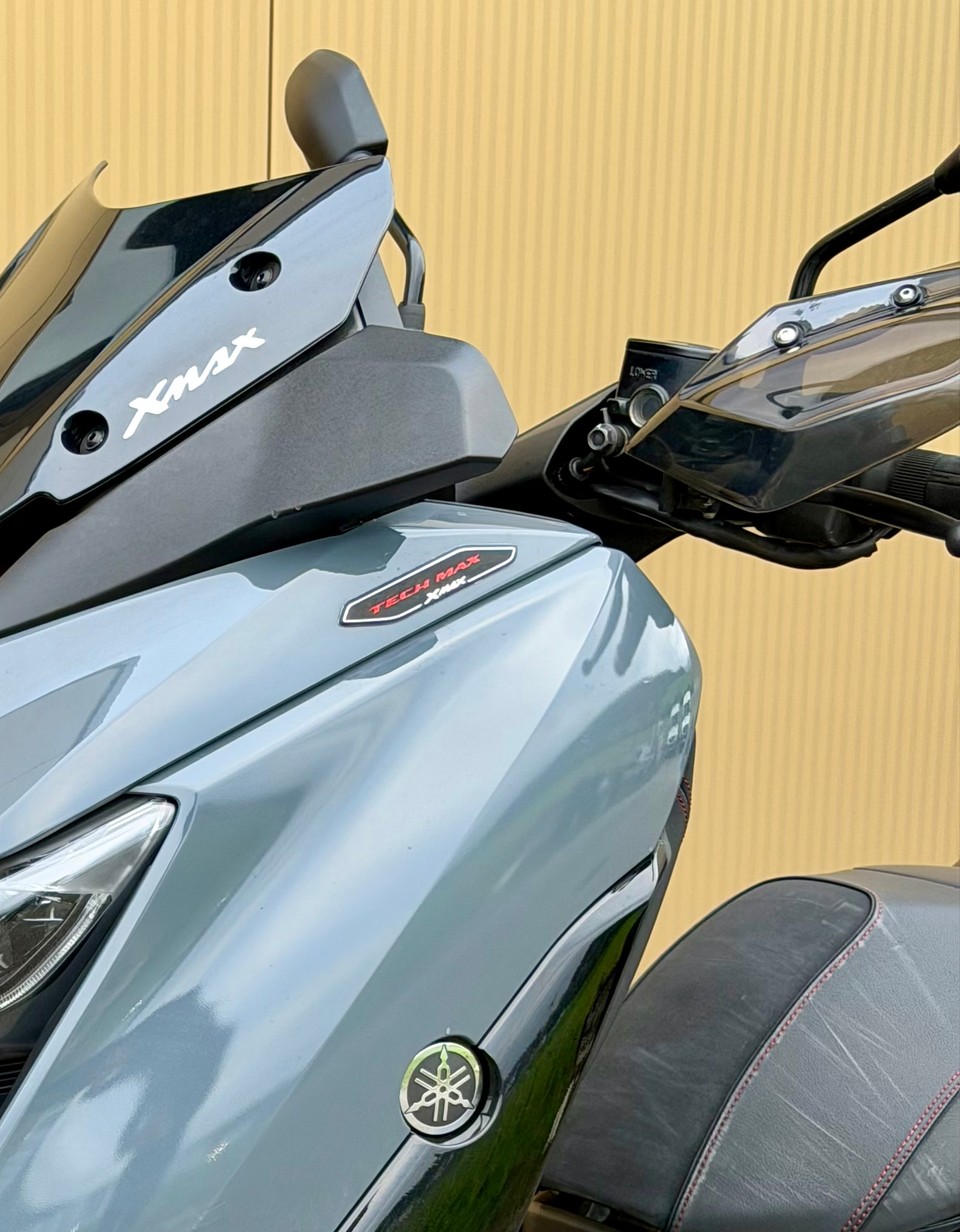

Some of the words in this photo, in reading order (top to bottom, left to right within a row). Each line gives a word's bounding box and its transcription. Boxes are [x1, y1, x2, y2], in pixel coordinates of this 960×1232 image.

[122, 327, 266, 440] XMAX
[629, 365, 658, 380] LOWER
[368, 578, 430, 616] TECH
[435, 553, 481, 584] MAX
[424, 575, 467, 605] XMAX
